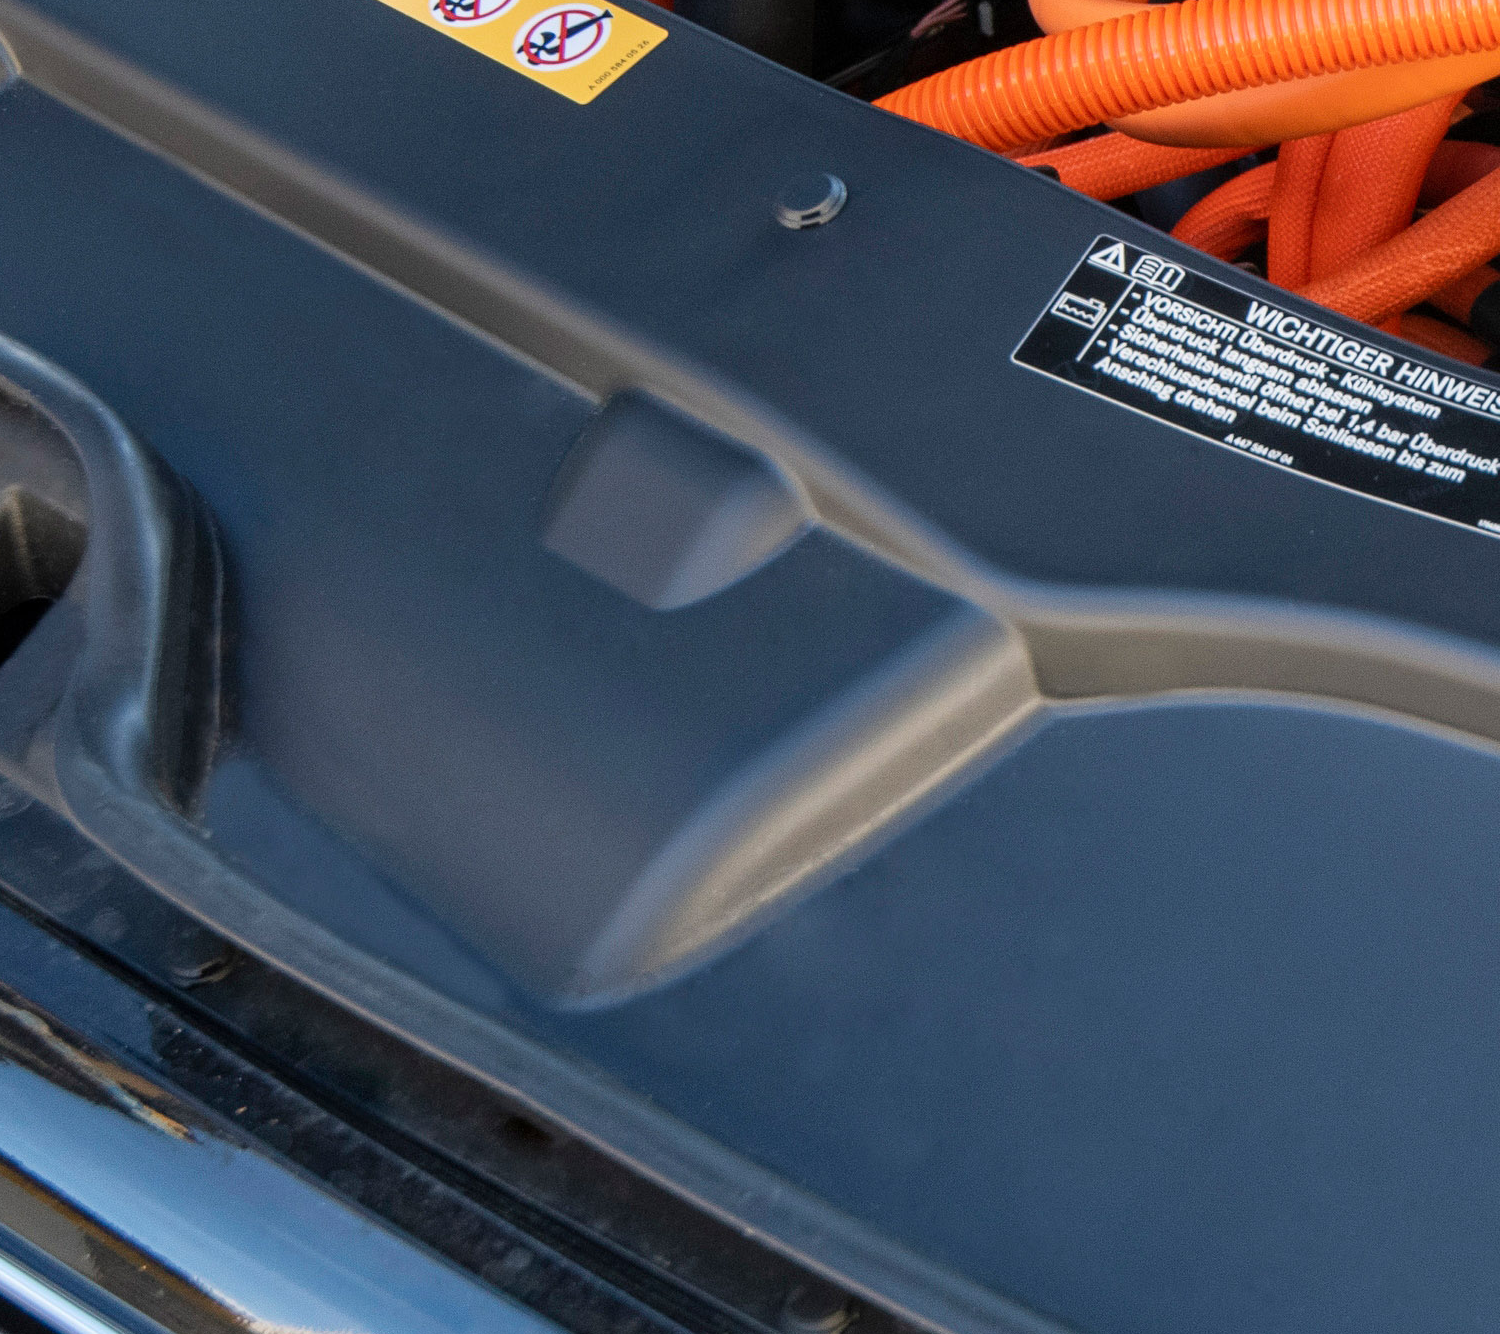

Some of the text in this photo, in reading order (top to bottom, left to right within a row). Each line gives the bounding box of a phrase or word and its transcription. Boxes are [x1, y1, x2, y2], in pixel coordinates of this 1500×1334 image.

[1093, 359, 1238, 424] Anschlag drehen
[1119, 325, 1261, 391] Sicherheitsventil
[1260, 380, 1312, 414] öffnet
[1313, 398, 1347, 424] bei
[1346, 414, 1377, 437] 1,4
[1377, 419, 1409, 446] bar
[1130, 306, 1220, 354] Überdruck
[1221, 346, 1295, 384] langsam
[1295, 378, 1373, 414] ablassen
[1142, 292, 1240, 343] VORSICHT!
[1239, 330, 1330, 378] Überdruck
[1339, 371, 1442, 419] Kühlsystem
[1245, 301, 1393, 377] WICHTIGER
[1108, 341, 1255, 409] Verschlussdeckel
[1257, 399, 1301, 428] beim
[1302, 417, 1396, 461] Schliessen
[1396, 448, 1426, 471] bis
[1424, 460, 1467, 483] zum
[1224, 433, 1235, 444] A
